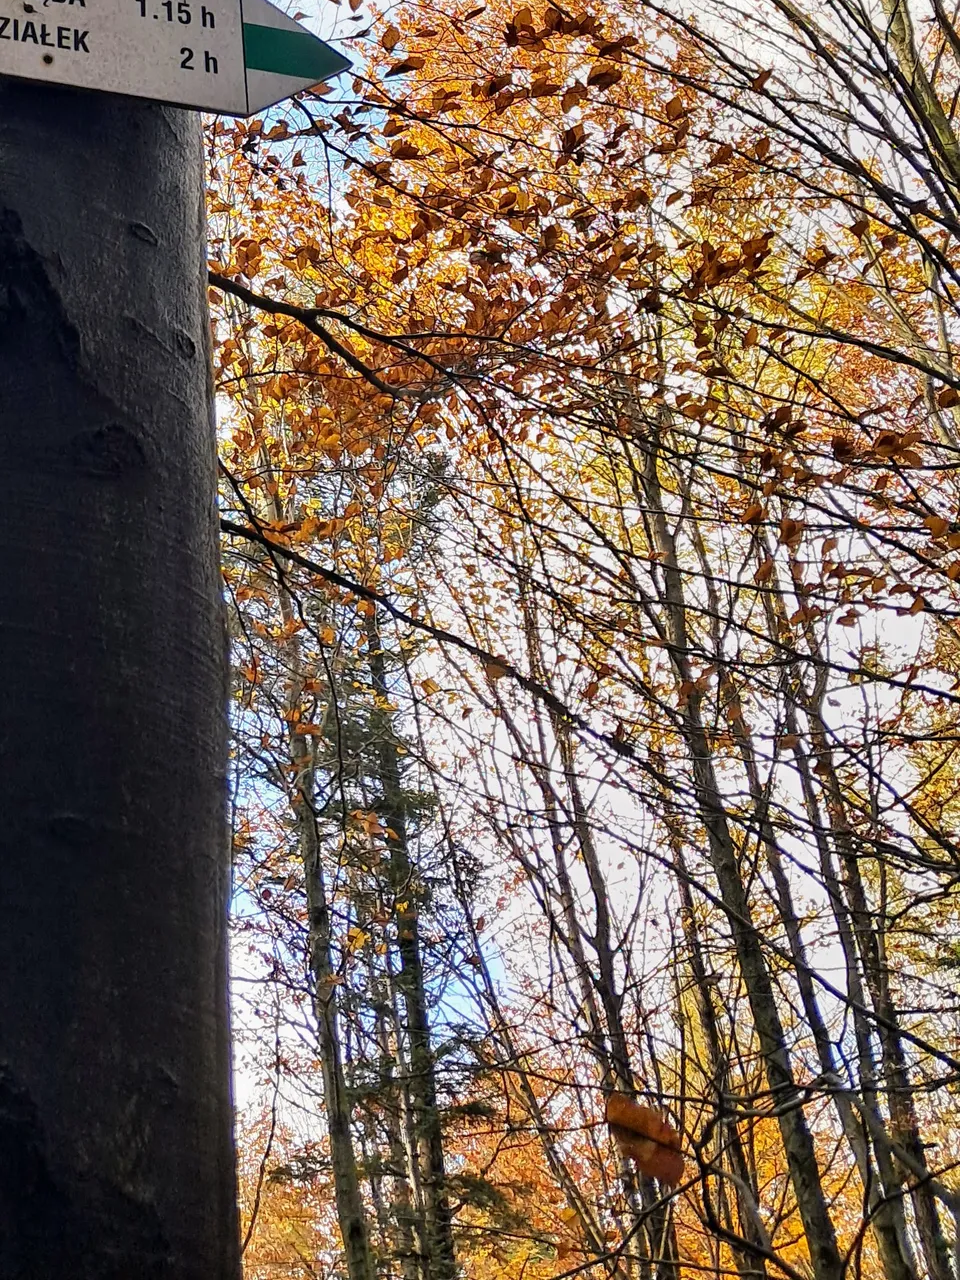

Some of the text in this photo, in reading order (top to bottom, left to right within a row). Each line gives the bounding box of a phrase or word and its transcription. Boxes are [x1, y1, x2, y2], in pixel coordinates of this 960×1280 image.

[201, 5, 216, 29] h
[180, 47, 195, 71] 2
[204, 50, 219, 74] h
